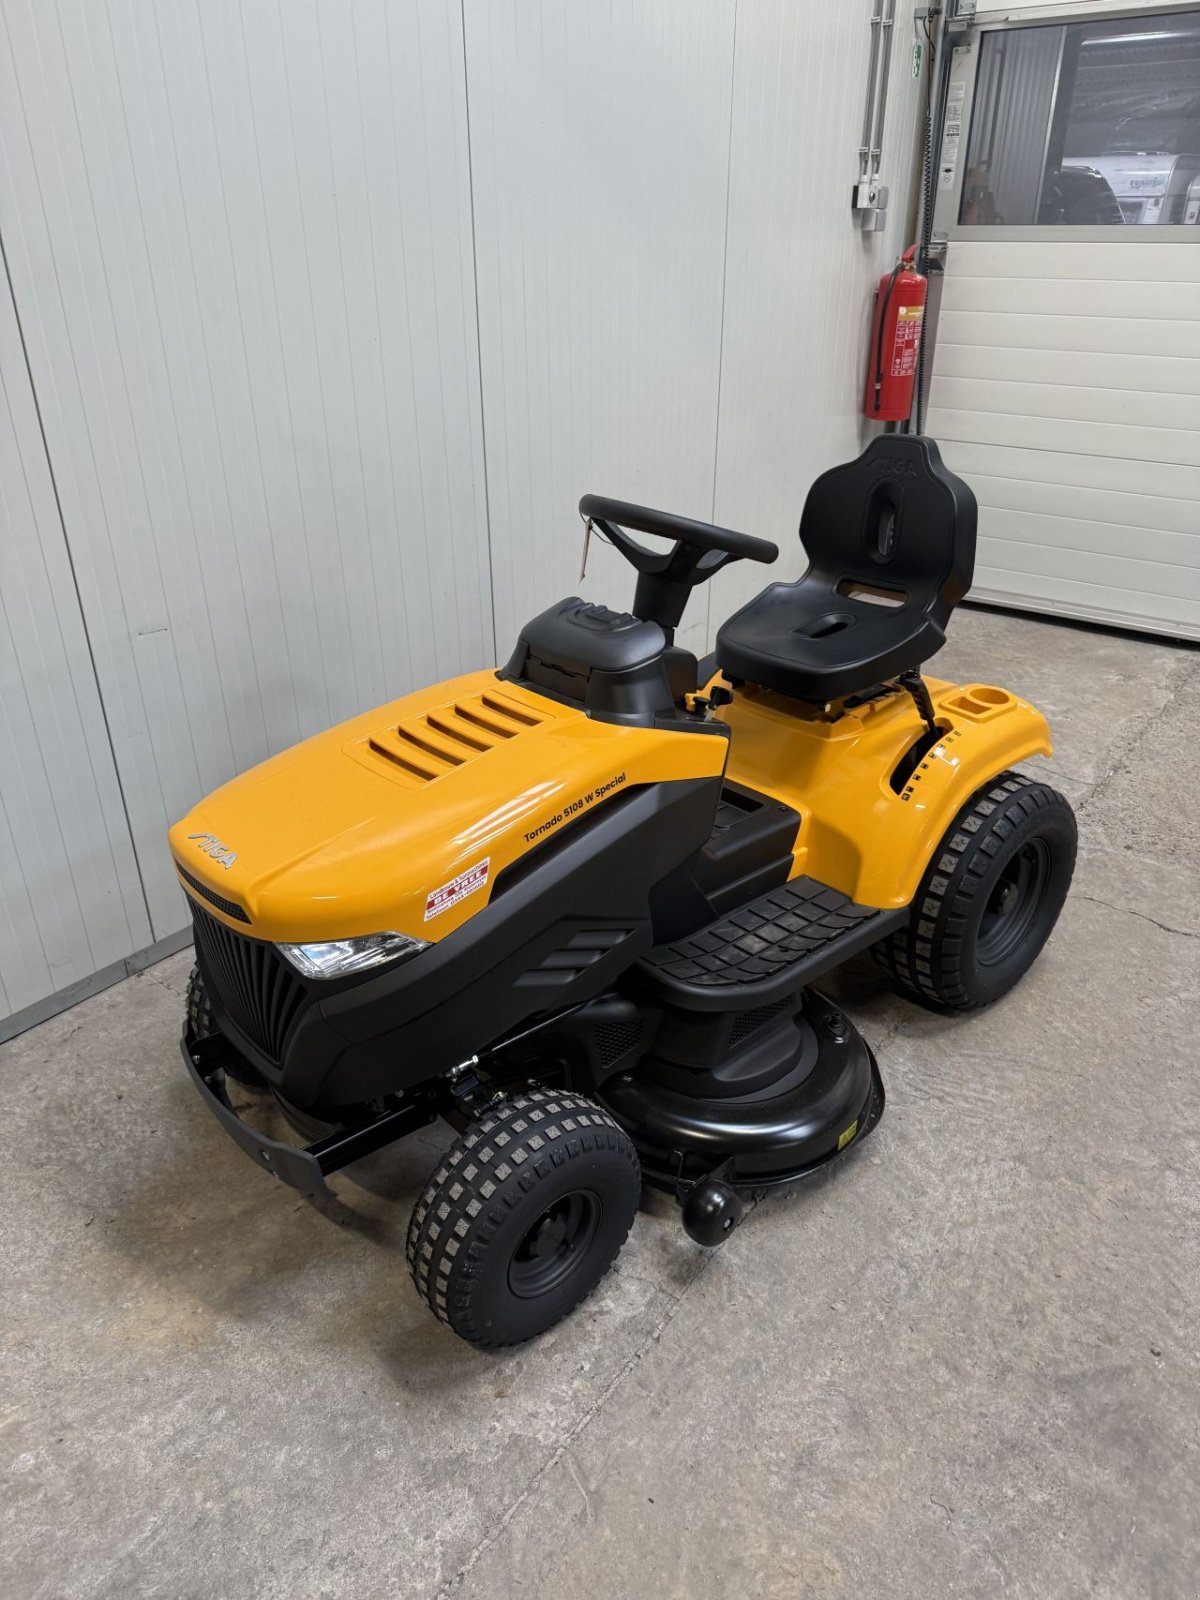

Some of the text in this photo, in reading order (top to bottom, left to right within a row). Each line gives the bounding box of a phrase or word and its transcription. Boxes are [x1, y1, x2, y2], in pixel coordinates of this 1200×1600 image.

[523, 772, 626, 843] Tornado 5108 W Special
[187, 832, 238, 870] STIGA
[434, 893, 449, 906] DE
[454, 871, 482, 891] VREE
